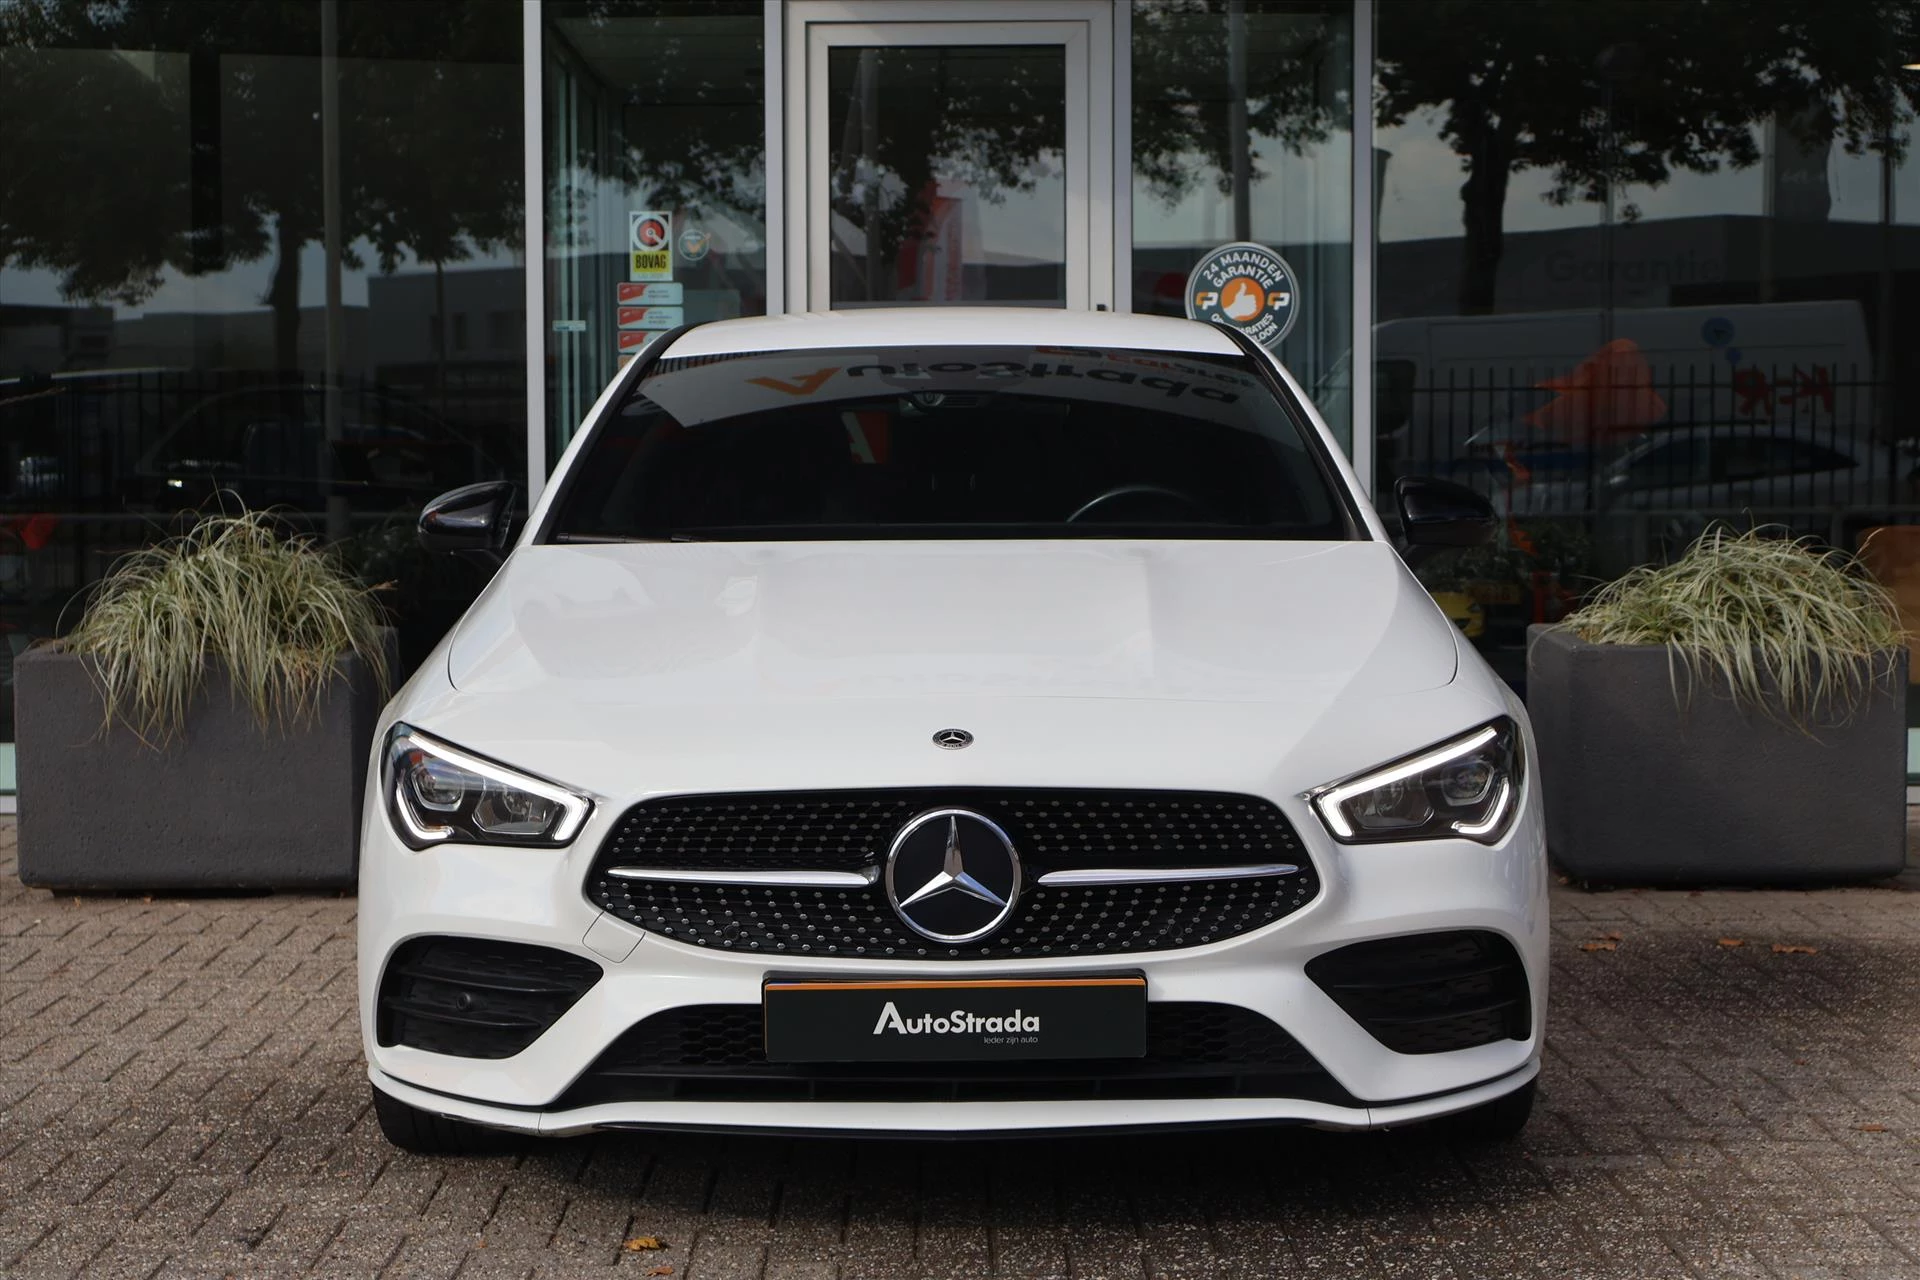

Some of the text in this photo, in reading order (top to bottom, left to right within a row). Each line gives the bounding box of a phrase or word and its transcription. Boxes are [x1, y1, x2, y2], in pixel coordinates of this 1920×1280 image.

[635, 254, 666, 269] BOVAG
[1203, 252, 1285, 282] 24 MAANDEN
[1213, 264, 1274, 289] GARANTIE
[873, 1001, 1040, 1035] AutoStrada
[1006, 1036, 1019, 1045] zijn
[1020, 1036, 1038, 1044] auto
